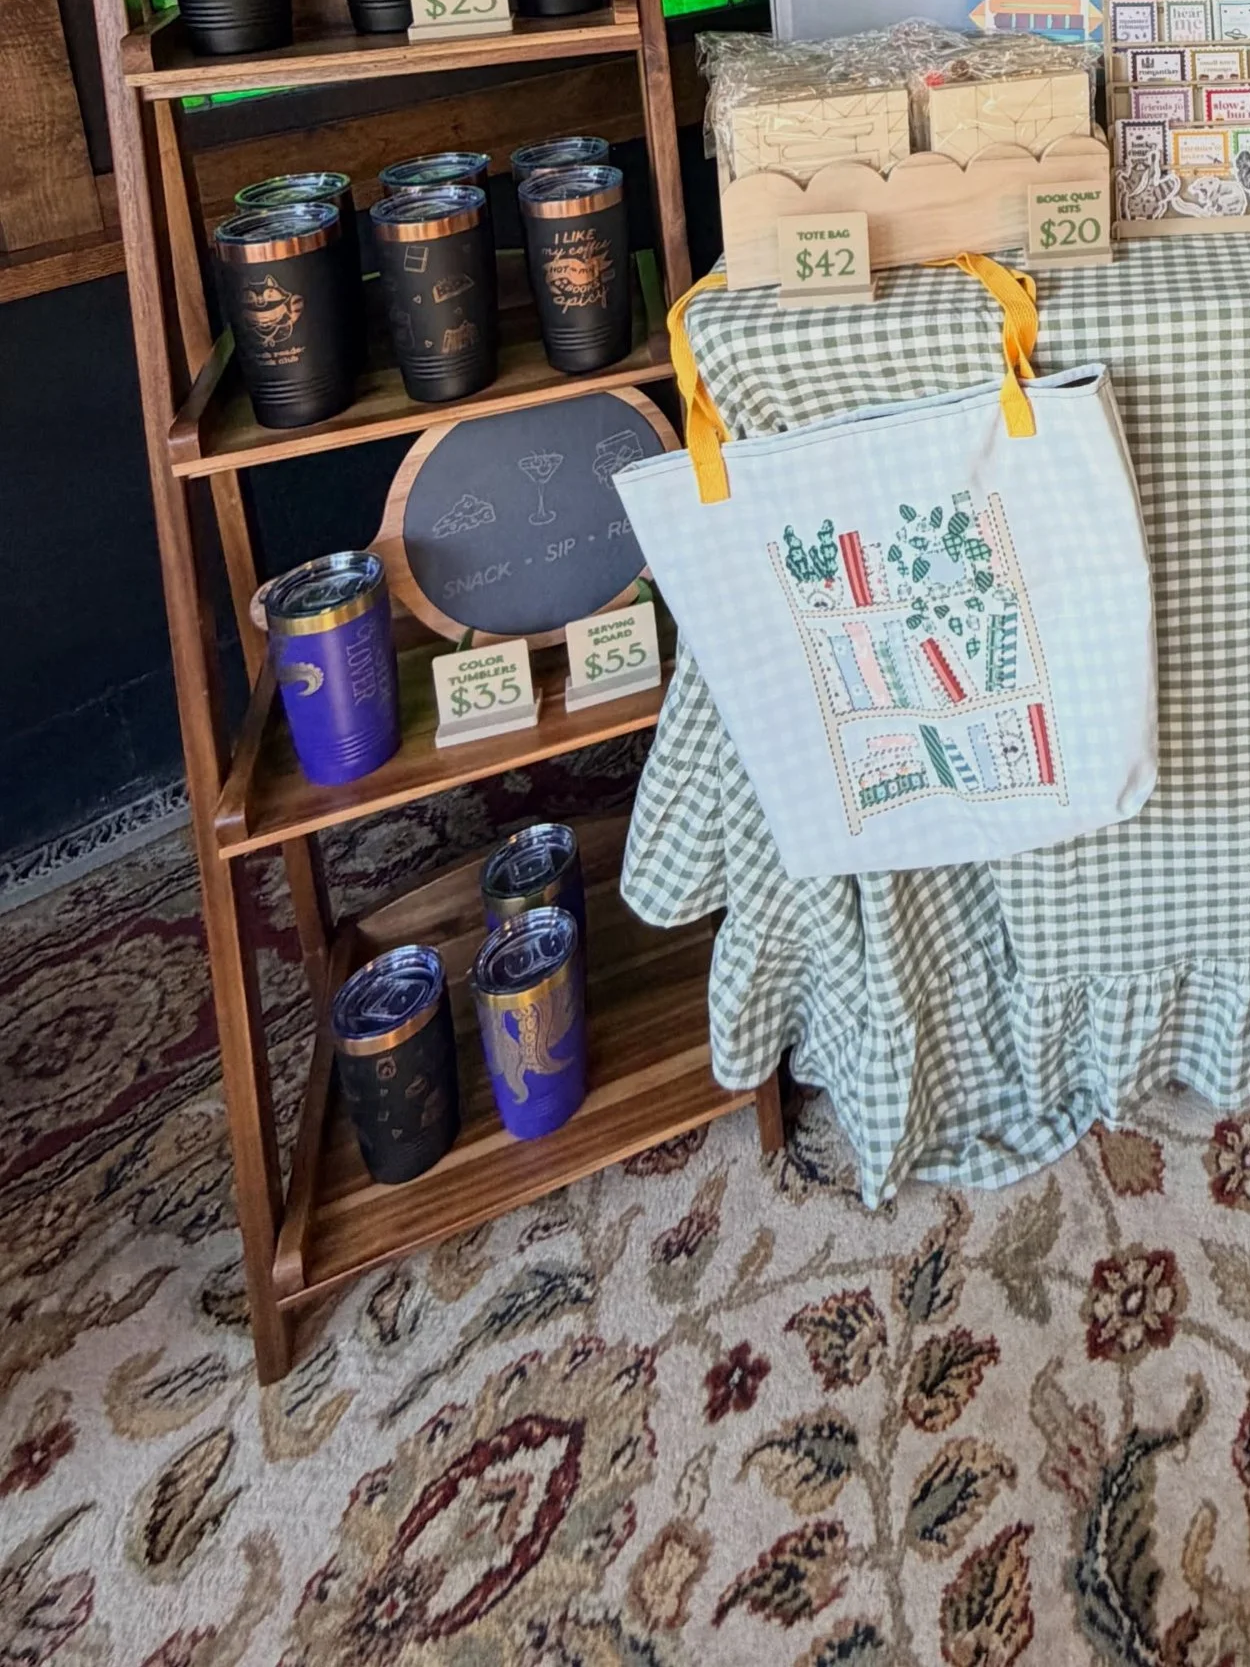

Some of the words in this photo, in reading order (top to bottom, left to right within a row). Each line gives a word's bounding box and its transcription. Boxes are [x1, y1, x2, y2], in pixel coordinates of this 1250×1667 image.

[1172, 7, 1203, 18] hear
[1141, 101, 1173, 112] friends
[1213, 100, 1240, 111] slow
[1036, 193, 1069, 204] BOOK
[1070, 191, 1102, 203] QUILT
[1058, 204, 1082, 214] KITS
[554, 233, 559, 245] I
[562, 228, 596, 244] LIKE
[796, 230, 826, 241] TOTE
[828, 229, 850, 240] BAG
[1039, 217, 1102, 249] $20
[542, 246, 566, 261] my
[568, 238, 611, 260] coffee
[796, 248, 856, 281] $42
[553, 286, 609, 314] spicy
[442, 562, 513, 601] SNACK
[545, 538, 577, 562] SIP
[587, 617, 636, 638] SERVING
[593, 629, 633, 646] BOARD
[458, 654, 504, 672] COLOR
[584, 642, 647, 681] $55
[448, 663, 517, 686] TUMBLERS
[450, 677, 522, 717] $35
